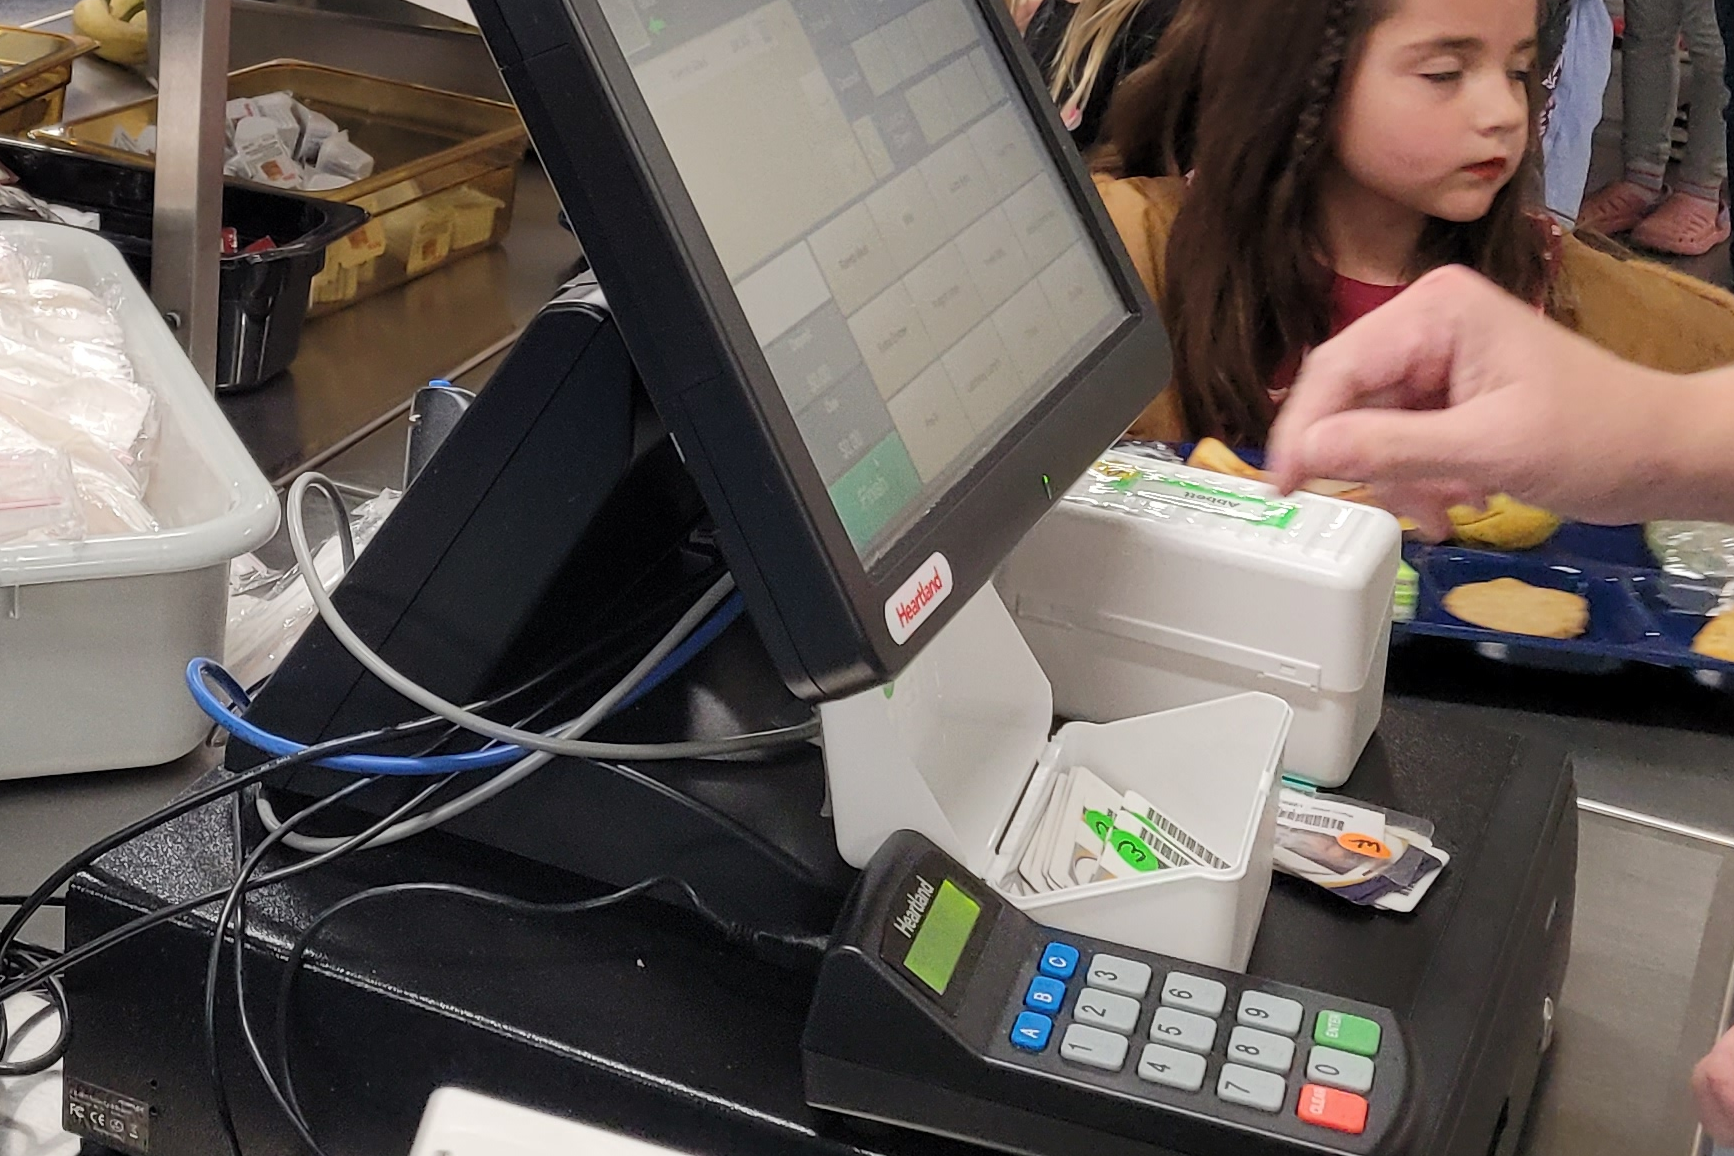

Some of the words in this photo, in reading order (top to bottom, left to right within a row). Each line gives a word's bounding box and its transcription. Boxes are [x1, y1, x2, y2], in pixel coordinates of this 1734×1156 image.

[895, 565, 943, 629] Heartland
[893, 874, 935, 939] Heartland
[1048, 956, 1067, 968] C
[1094, 970, 1118, 981] 3
[1033, 992, 1053, 1003] B
[1168, 988, 1193, 999] 6
[1081, 1004, 1106, 1017] 2
[1244, 1007, 1270, 1019] 9
[1019, 1027, 1040, 1039] A
[1158, 1023, 1182, 1036] 5
[1068, 1042, 1093, 1052] 1
[1235, 1044, 1260, 1056] 8
[1146, 1061, 1171, 1073] 4
[1314, 1064, 1340, 1076] 0
[1224, 1080, 1251, 1094] 7
